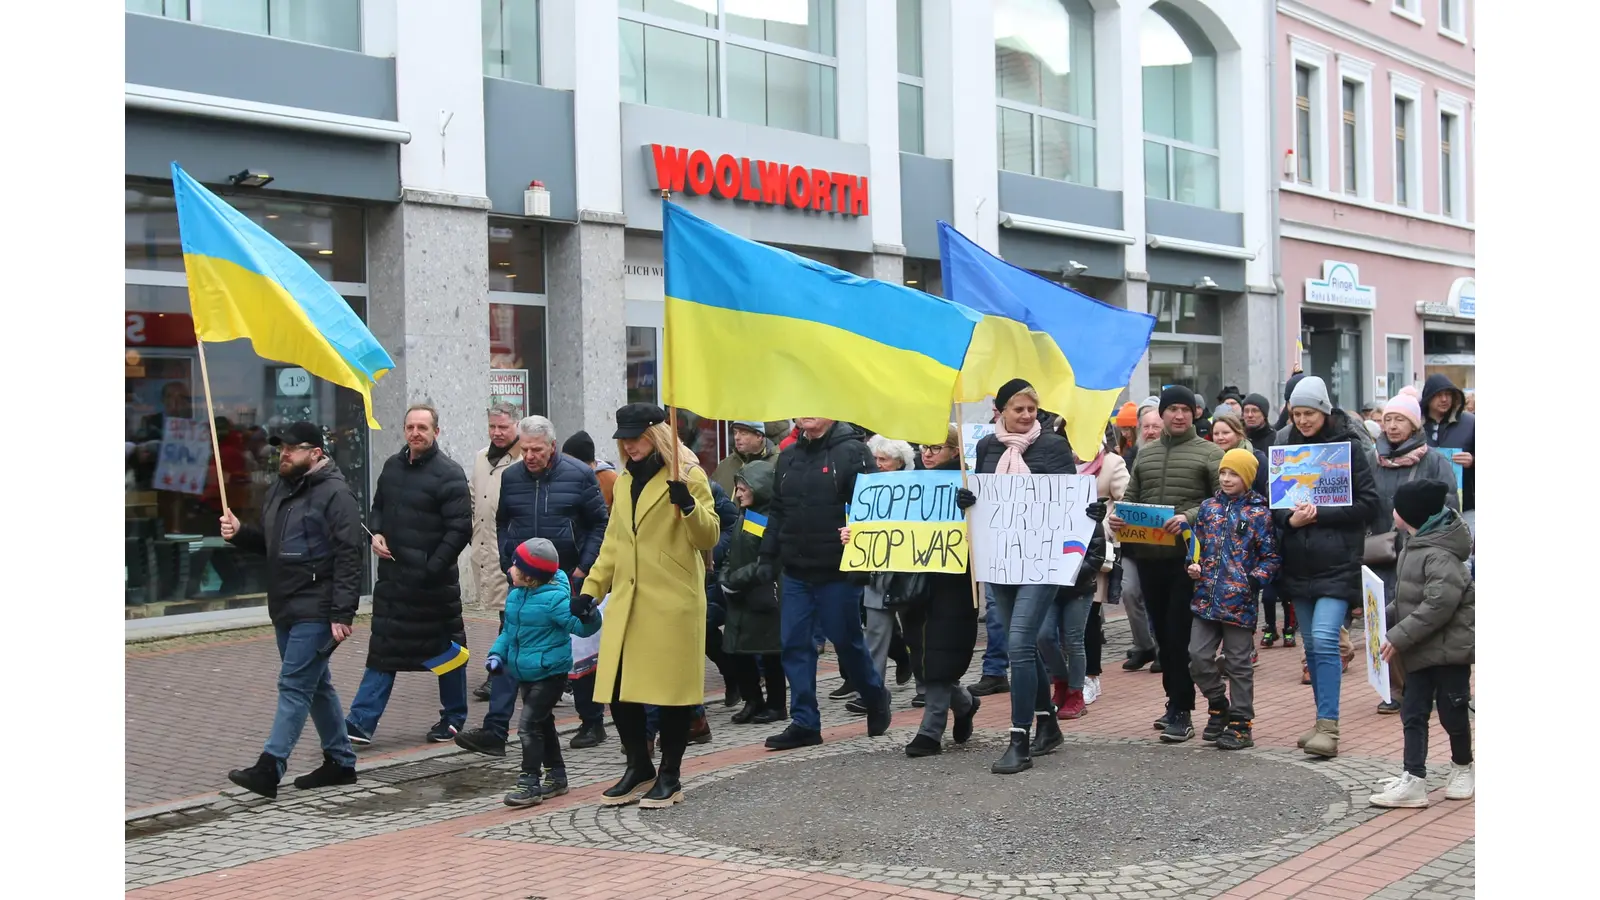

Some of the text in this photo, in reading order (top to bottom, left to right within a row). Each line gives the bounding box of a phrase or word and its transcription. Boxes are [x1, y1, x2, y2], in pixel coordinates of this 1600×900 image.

[650, 143, 868, 217] WOOLWORTH
[490, 374, 520, 382] OLWORTH
[490, 384, 523, 395] ERBUNG
[1319, 477, 1348, 486] RUSSIA
[1313, 485, 1348, 494] TERRORIST
[854, 484, 906, 521] STOP
[1313, 495, 1348, 504] STOP WAR
[988, 501, 1074, 531] ZURÜCK
[1119, 509, 1148, 522] STOP
[1119, 529, 1147, 539] WAR
[849, 529, 963, 568] STOP WAR
[989, 557, 1060, 583] HAUSE
